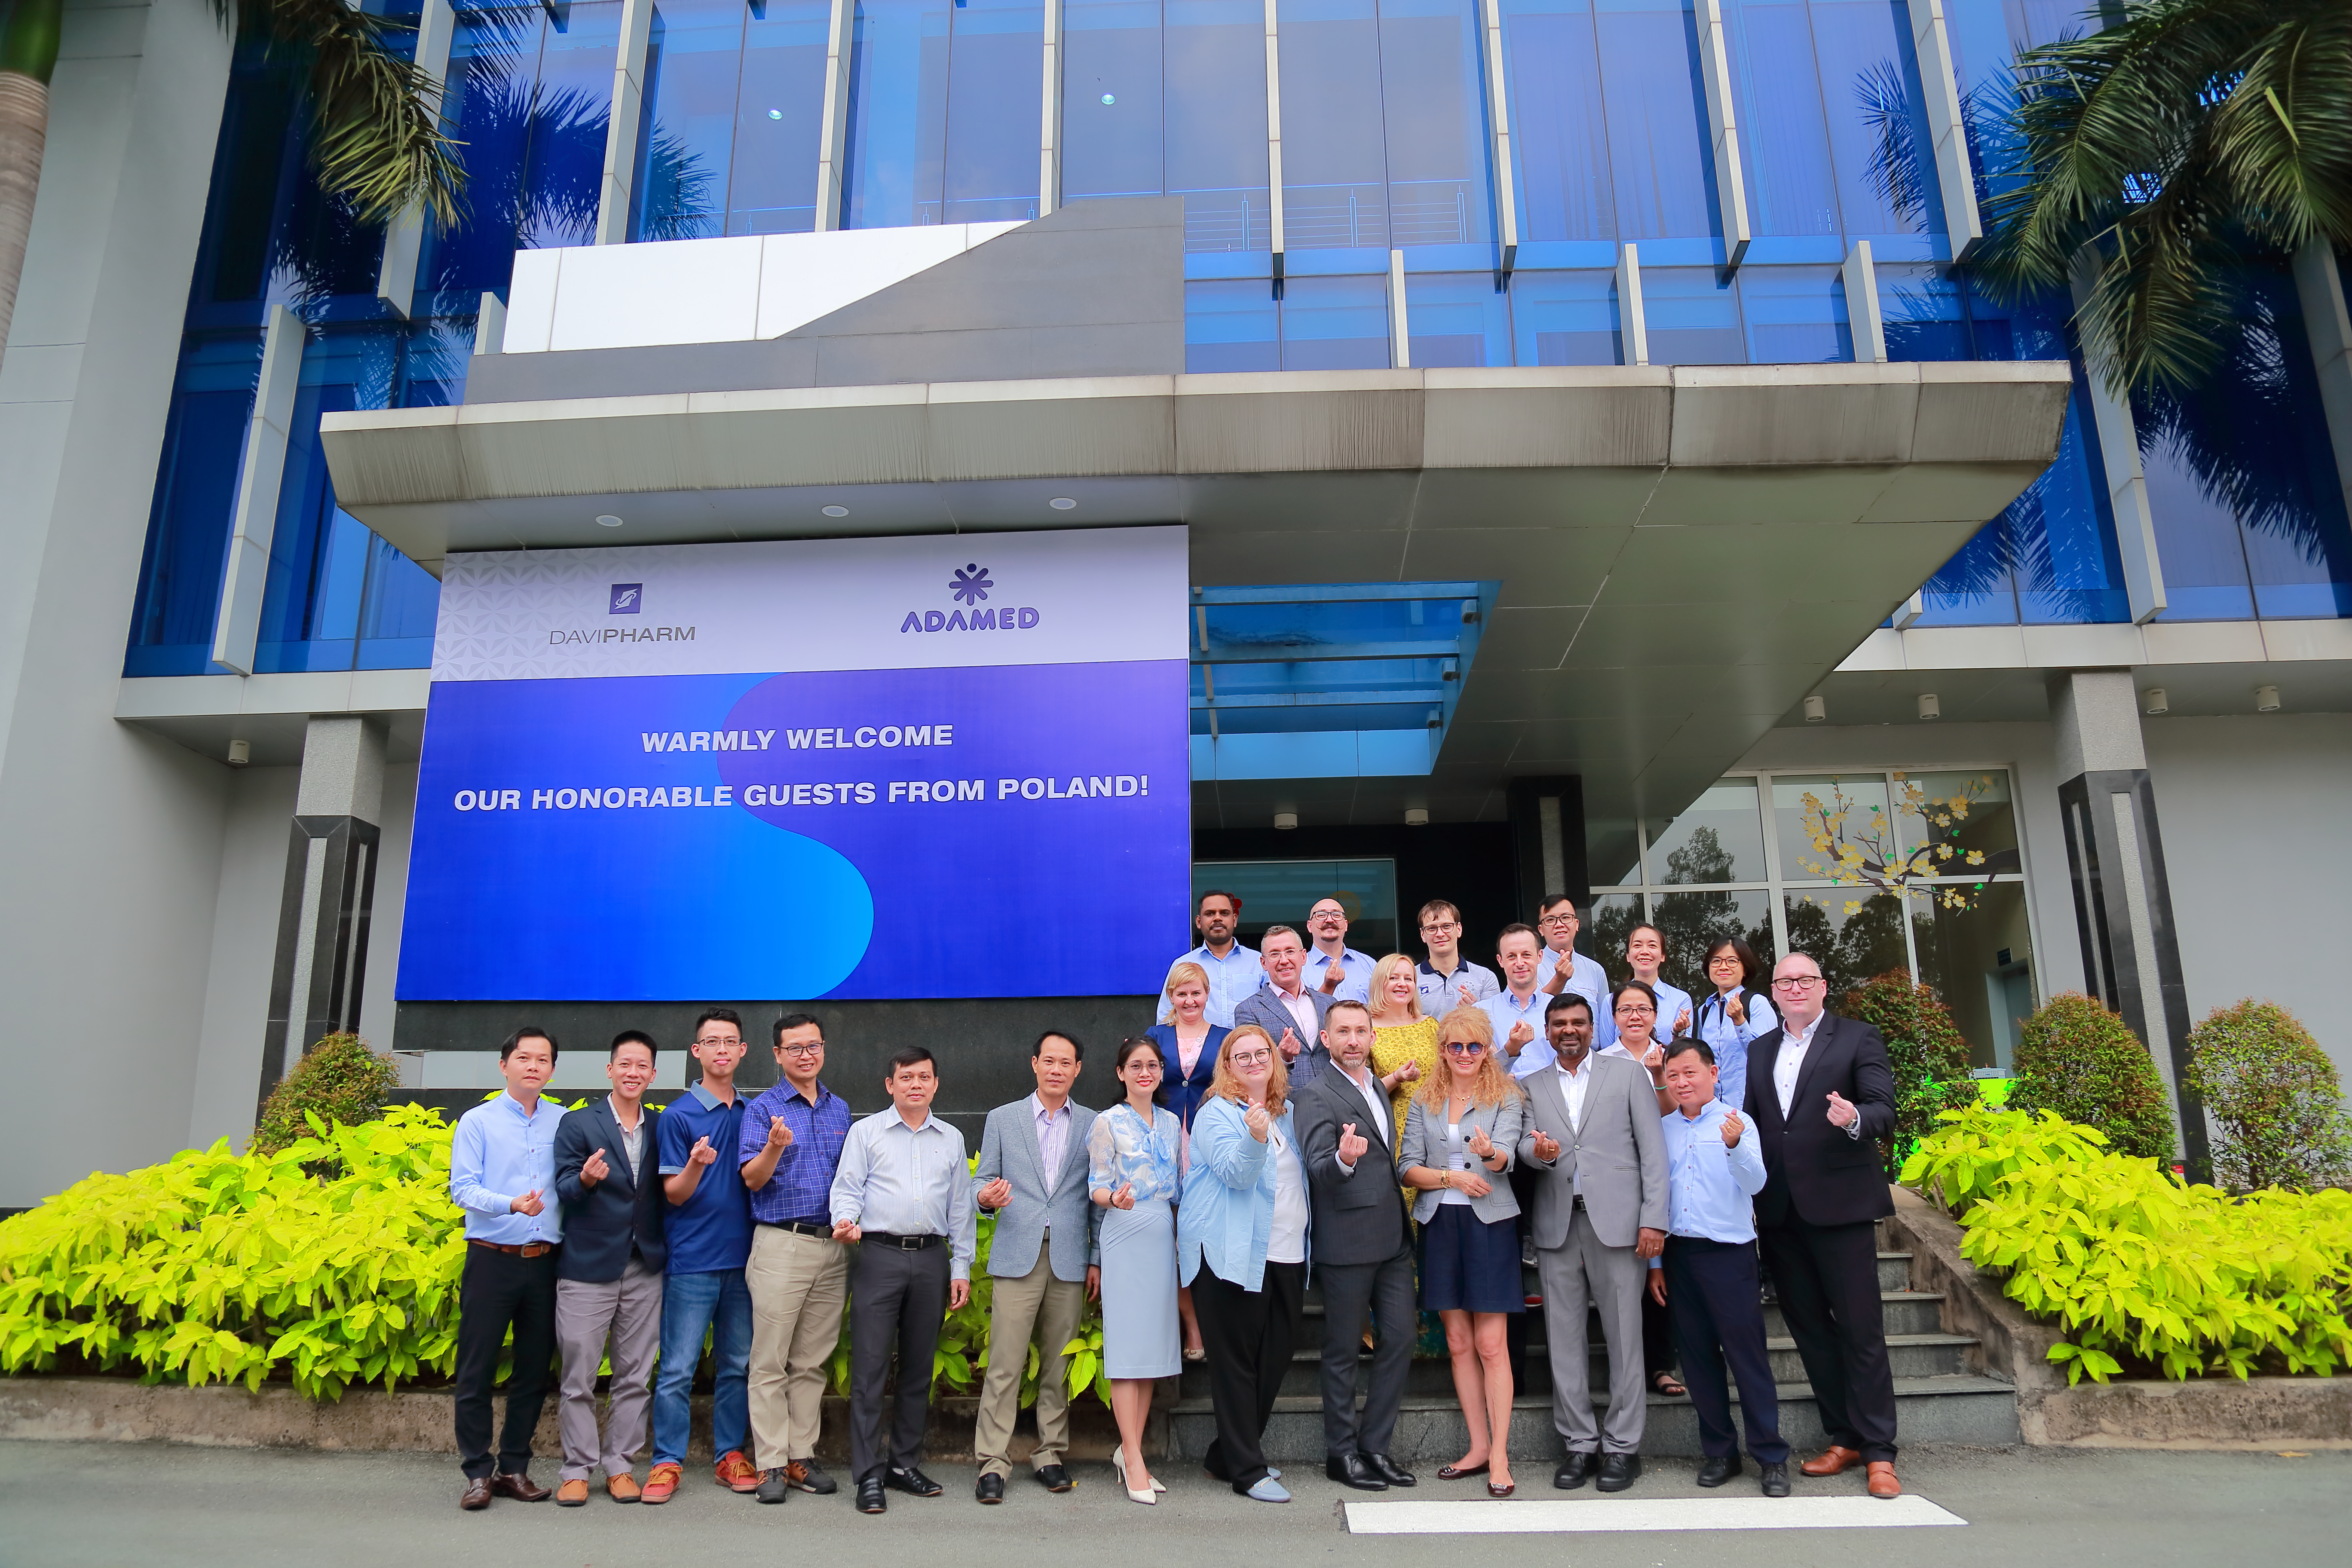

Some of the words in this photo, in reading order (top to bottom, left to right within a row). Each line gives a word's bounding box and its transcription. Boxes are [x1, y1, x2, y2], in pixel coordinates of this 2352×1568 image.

[900, 607, 1039, 633] ADAMED
[550, 627, 695, 644] DAVIPHARM
[641, 729, 777, 753] WARMLY
[786, 725, 953, 750] WELCOME
[454, 790, 521, 811] OUR
[532, 785, 733, 810] HONORABLE
[744, 782, 876, 806] GUESTS
[888, 779, 985, 803] FROM
[998, 775, 1148, 800] POLAND!
